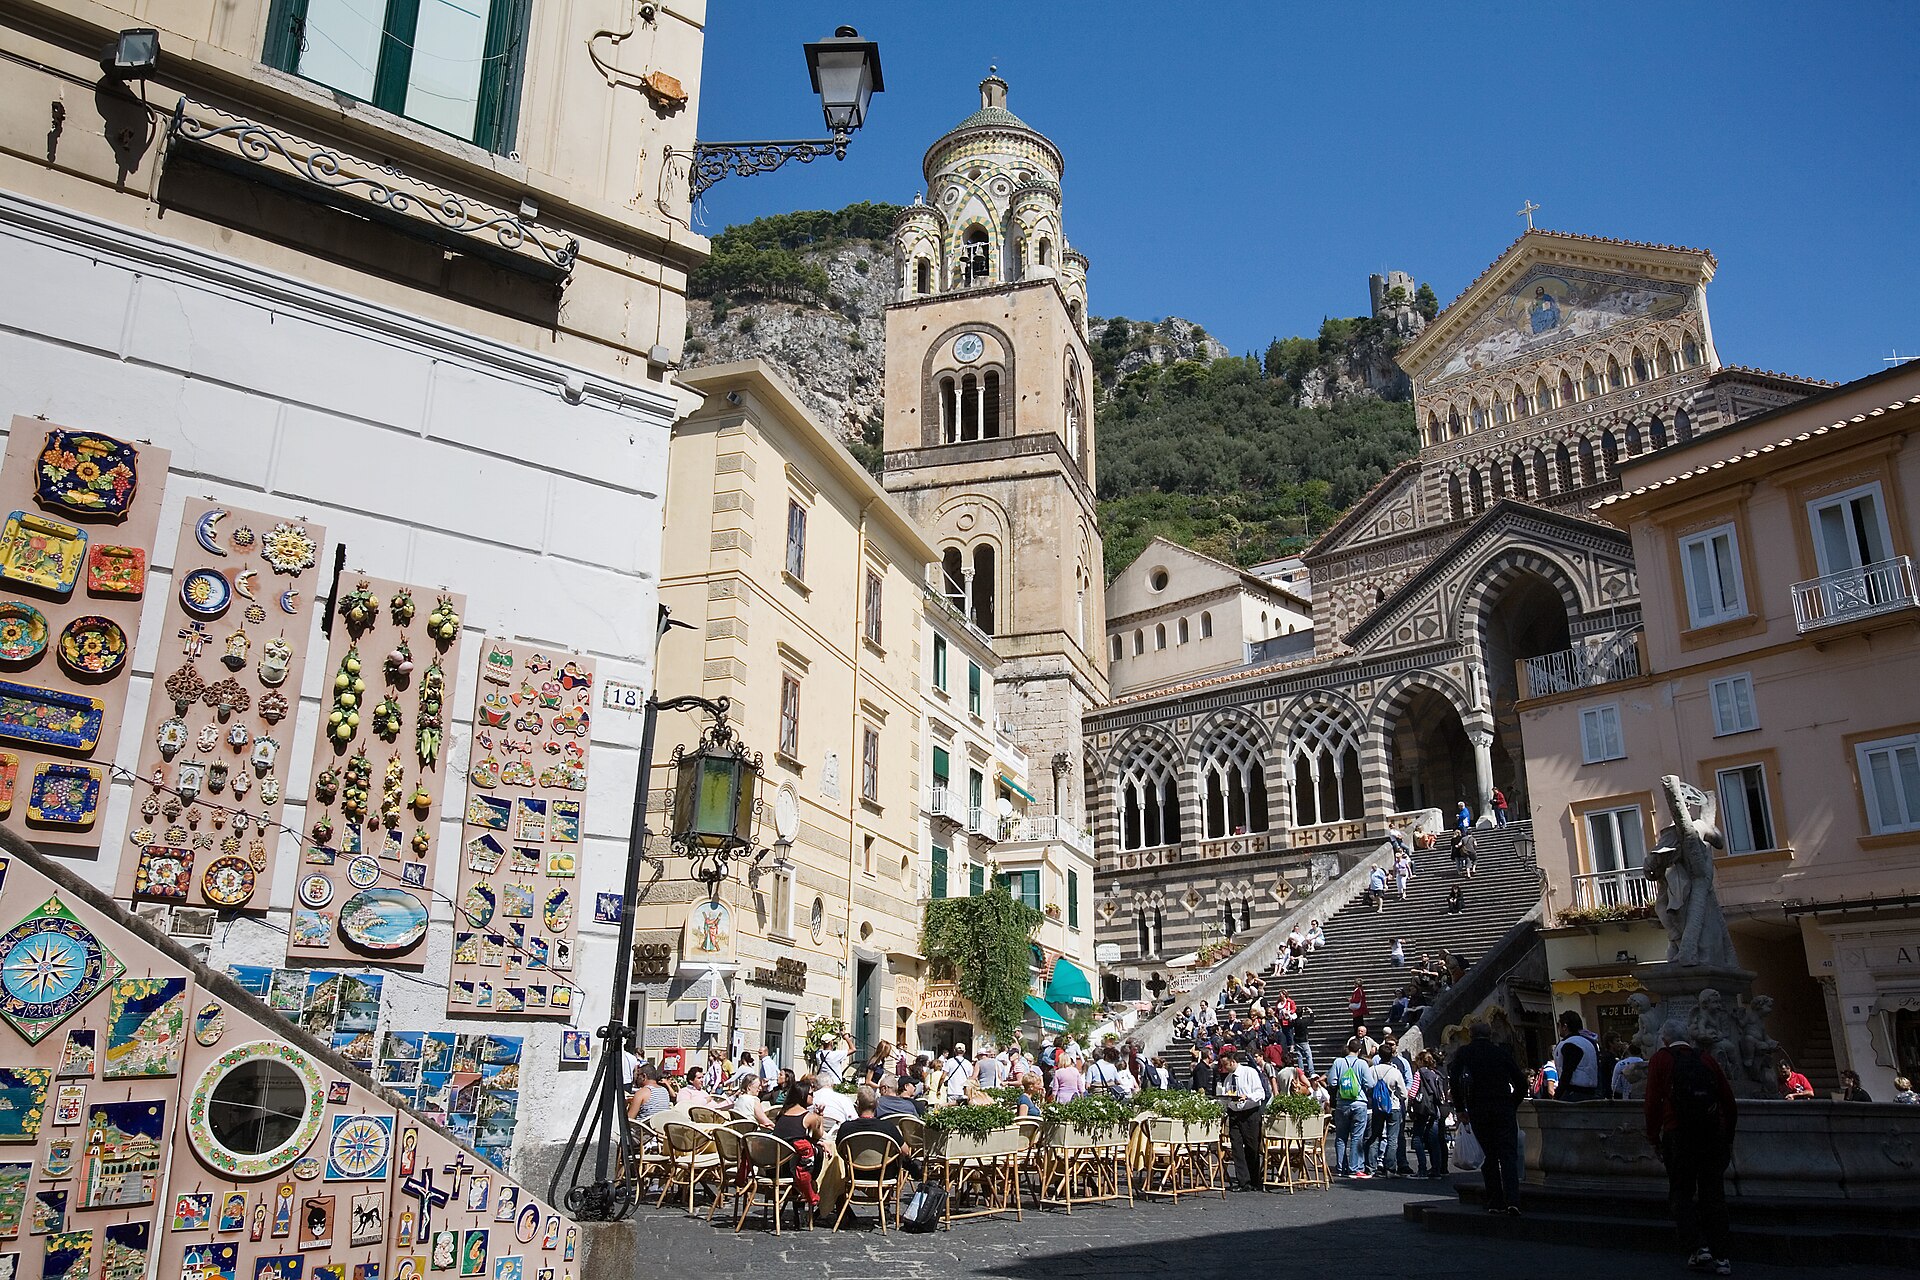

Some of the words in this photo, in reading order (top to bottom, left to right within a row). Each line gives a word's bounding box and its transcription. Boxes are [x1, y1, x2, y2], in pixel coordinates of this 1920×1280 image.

[613, 688, 636, 706] 18
[1822, 960, 1833, 968] 40
[919, 988, 971, 1001] RISTORAN
[925, 1000, 964, 1009] PIZZERIA
[921, 1011, 930, 1020] S.
[931, 1009, 968, 1020] ANDREA
